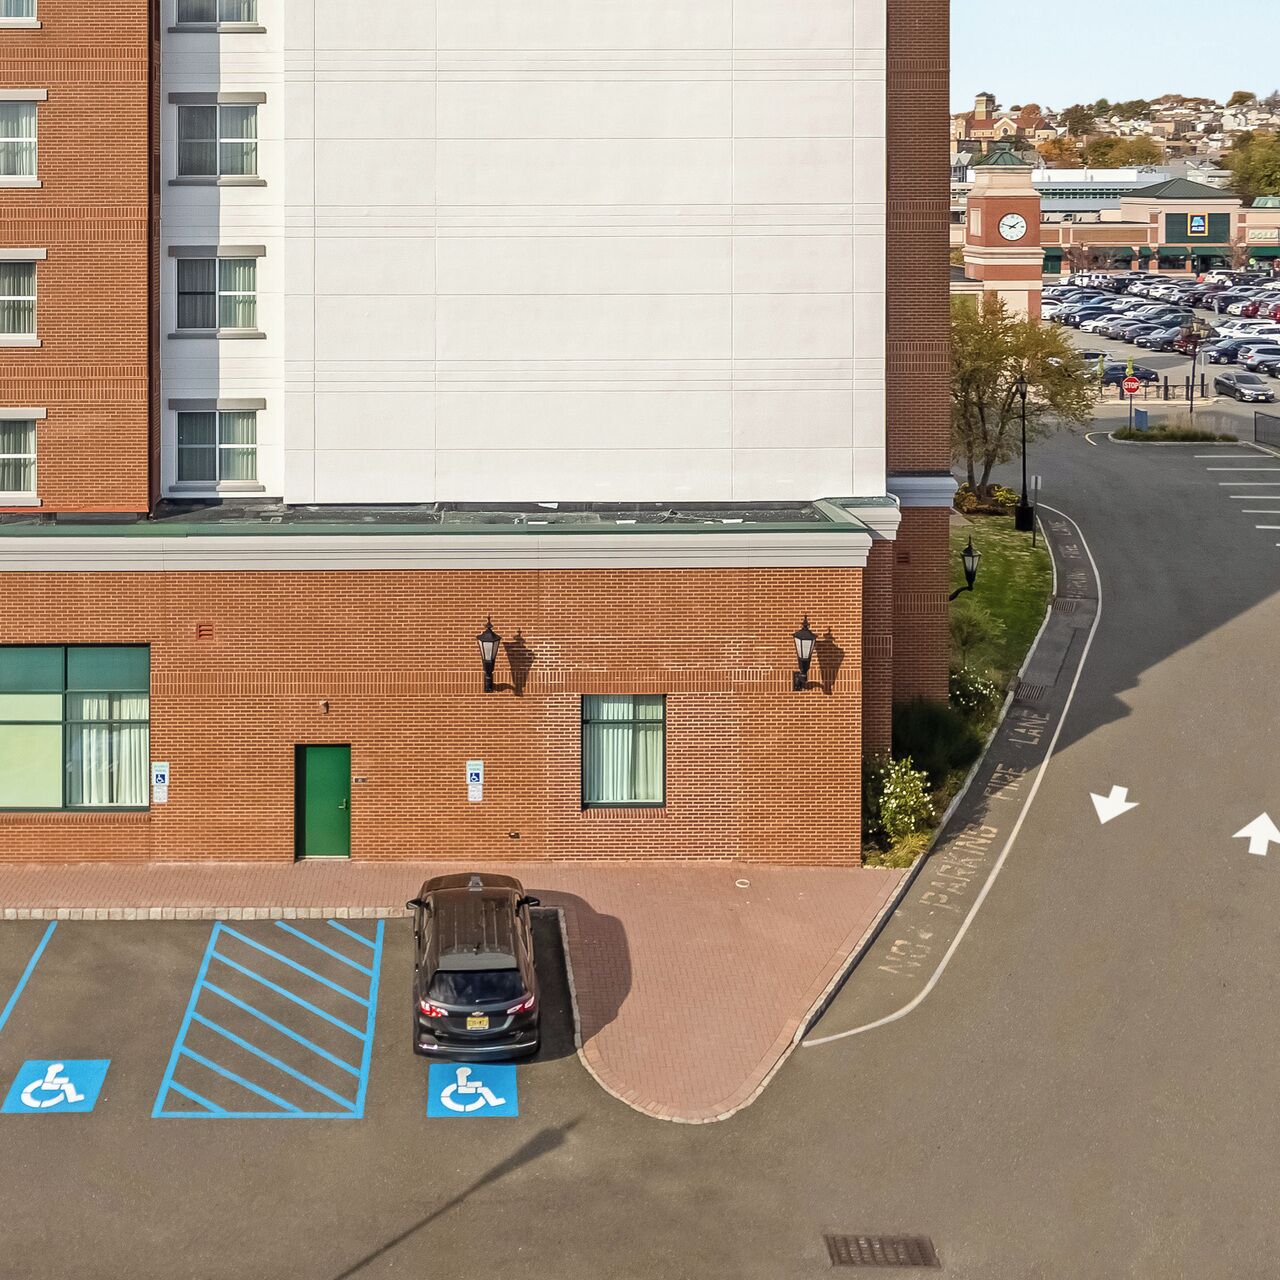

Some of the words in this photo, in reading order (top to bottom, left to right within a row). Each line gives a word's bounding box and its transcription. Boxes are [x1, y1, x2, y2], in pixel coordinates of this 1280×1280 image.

[1123, 381, 1140, 389] STOP
[919, 822, 999, 910] PARKING
[984, 763, 1028, 801] FIRE
[1008, 710, 1050, 745] LANE
